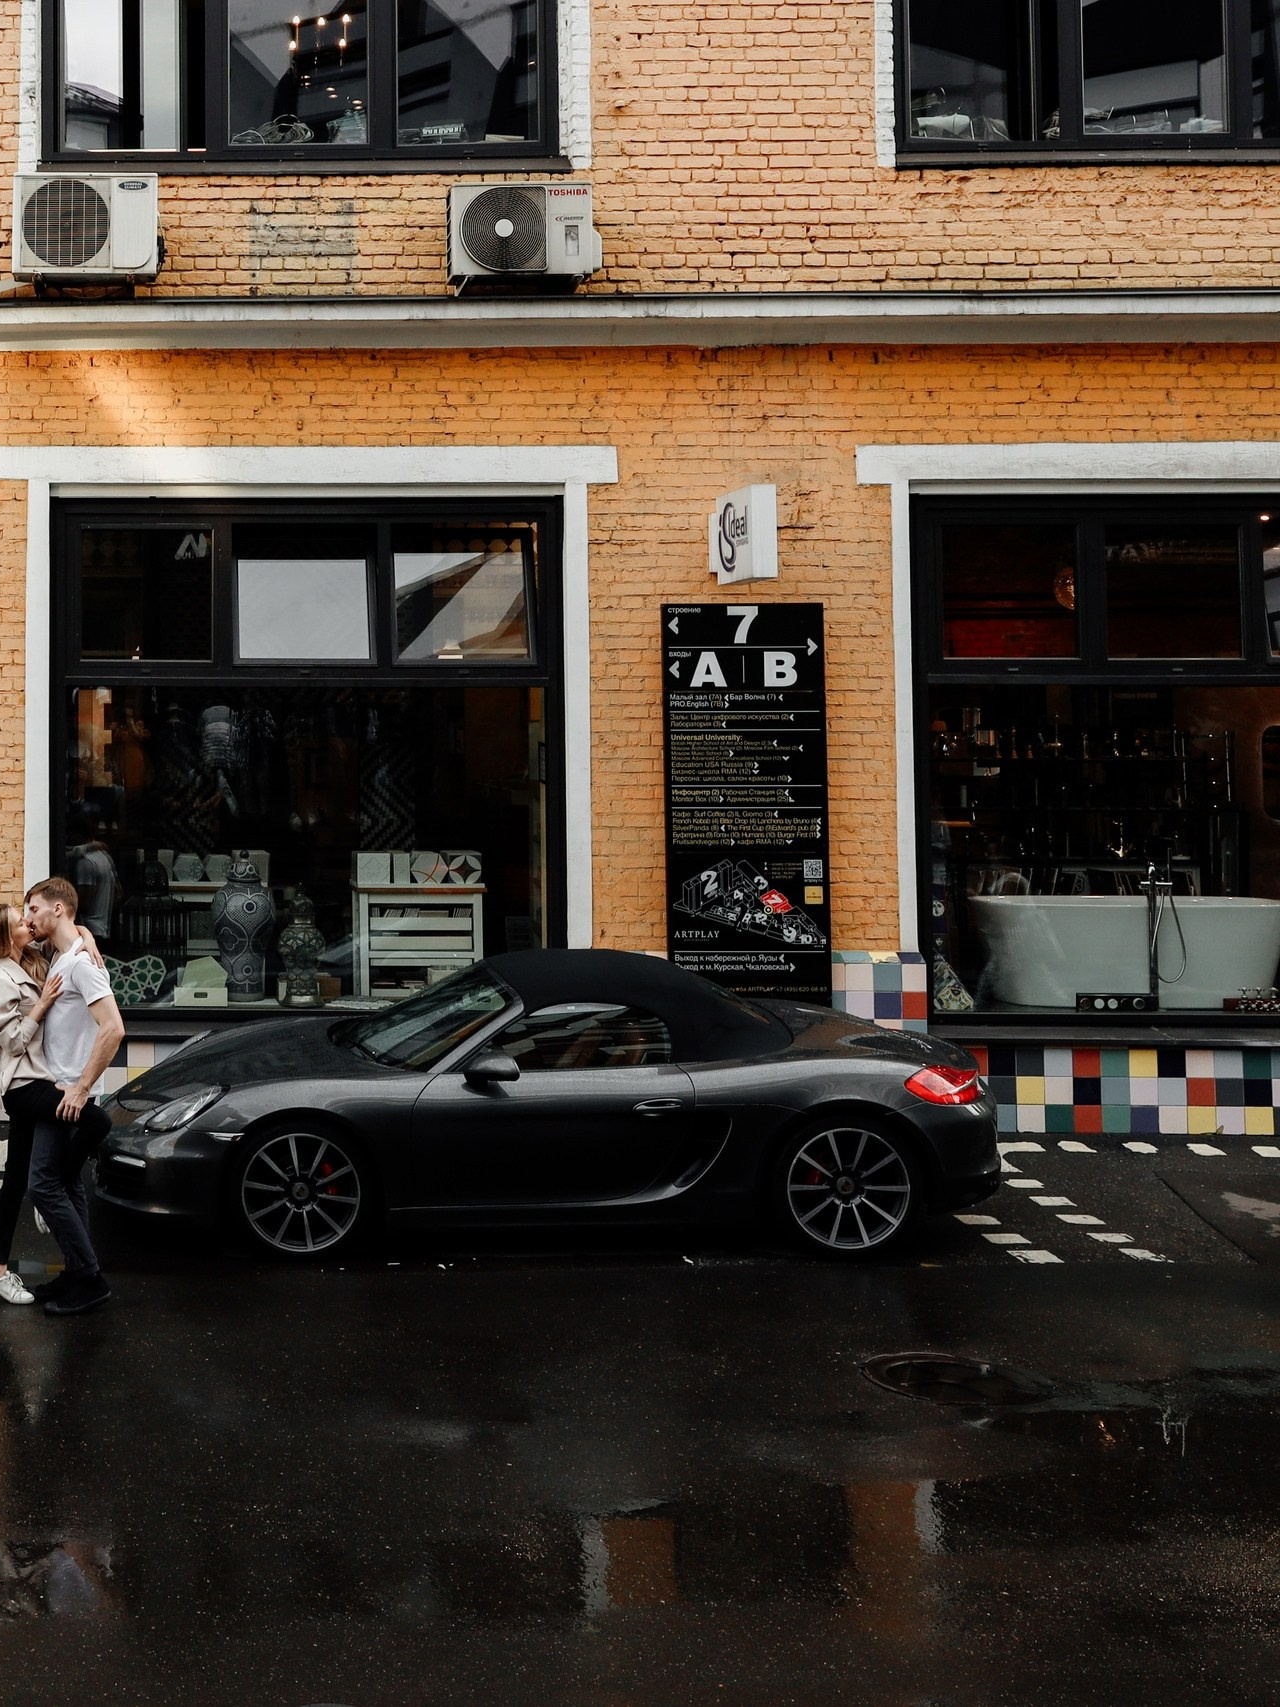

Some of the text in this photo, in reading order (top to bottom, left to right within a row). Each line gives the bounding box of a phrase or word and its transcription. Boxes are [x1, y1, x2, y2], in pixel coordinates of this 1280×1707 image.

[728, 505, 748, 538] Ideal
[726, 606, 758, 644] 7
[690, 652, 798, 687] A B
[700, 870, 718, 894] 2
[754, 876, 768, 890] 3
[733, 889, 744, 900] 4
[768, 894, 782, 904] 7
[754, 912, 768, 925] 12
[783, 927, 796, 942] 9
[799, 935, 812, 944] 10
[758, 955, 778, 963] Яузы
